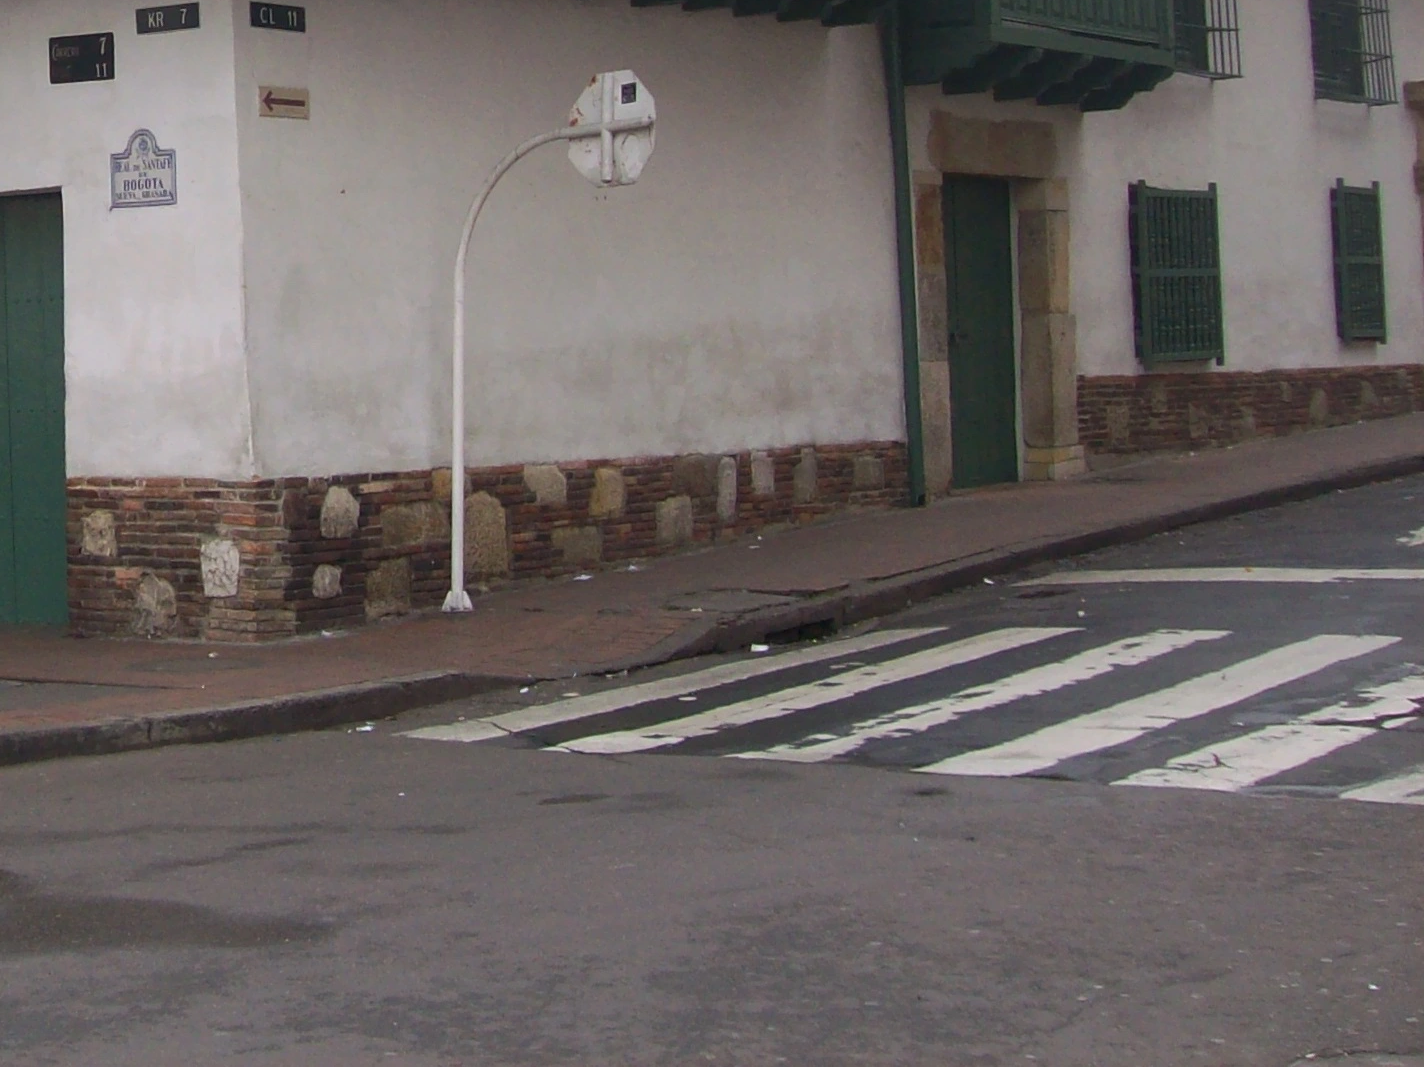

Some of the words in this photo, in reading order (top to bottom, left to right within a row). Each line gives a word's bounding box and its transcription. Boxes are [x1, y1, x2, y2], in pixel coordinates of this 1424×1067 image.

[147, 11, 164, 29] KR
[179, 8, 188, 24] 7
[259, 6, 276, 24] CL
[287, 10, 298, 28] 11
[96, 37, 107, 56] 7
[96, 62, 108, 77] 11
